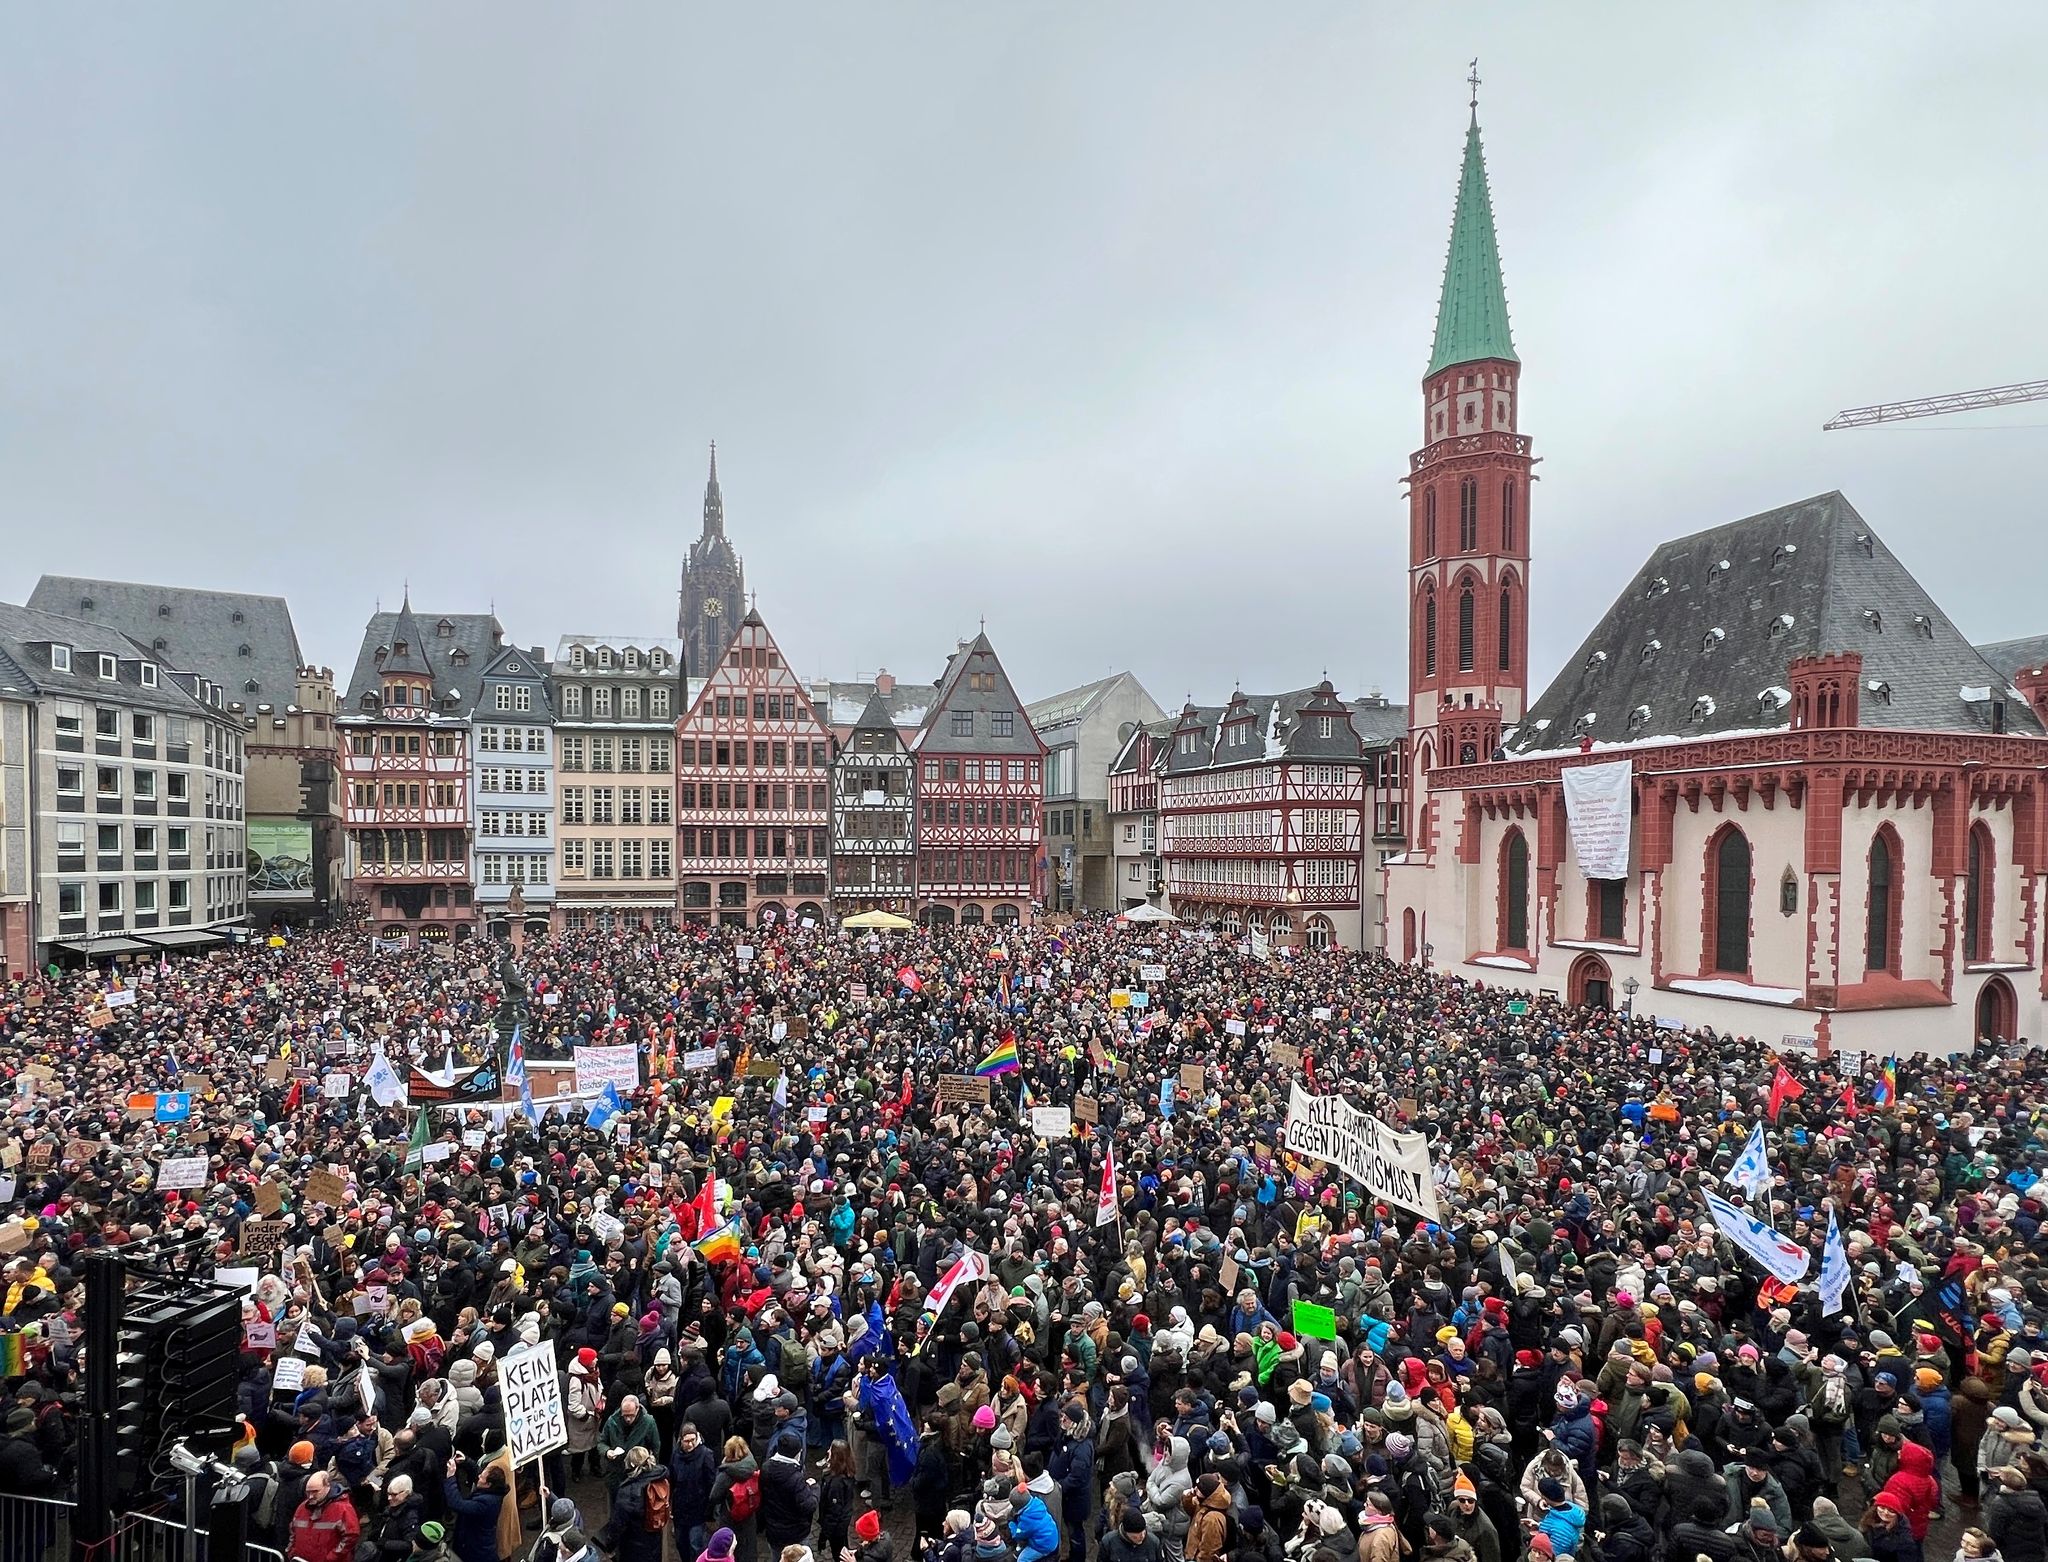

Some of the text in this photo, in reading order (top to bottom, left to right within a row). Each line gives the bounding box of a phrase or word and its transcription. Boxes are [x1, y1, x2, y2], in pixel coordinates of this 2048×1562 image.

[1308, 1097, 1339, 1128] ALLE
[1289, 1120, 1329, 1156] GEGEN
[244, 1221, 280, 1233] Kinder
[247, 1233, 282, 1244] GEGEN
[505, 1353, 551, 1390] KEIN
[507, 1378, 558, 1418] PLATZ
[526, 1408, 546, 1427] FÜR
[510, 1414, 561, 1458] NAZIS
